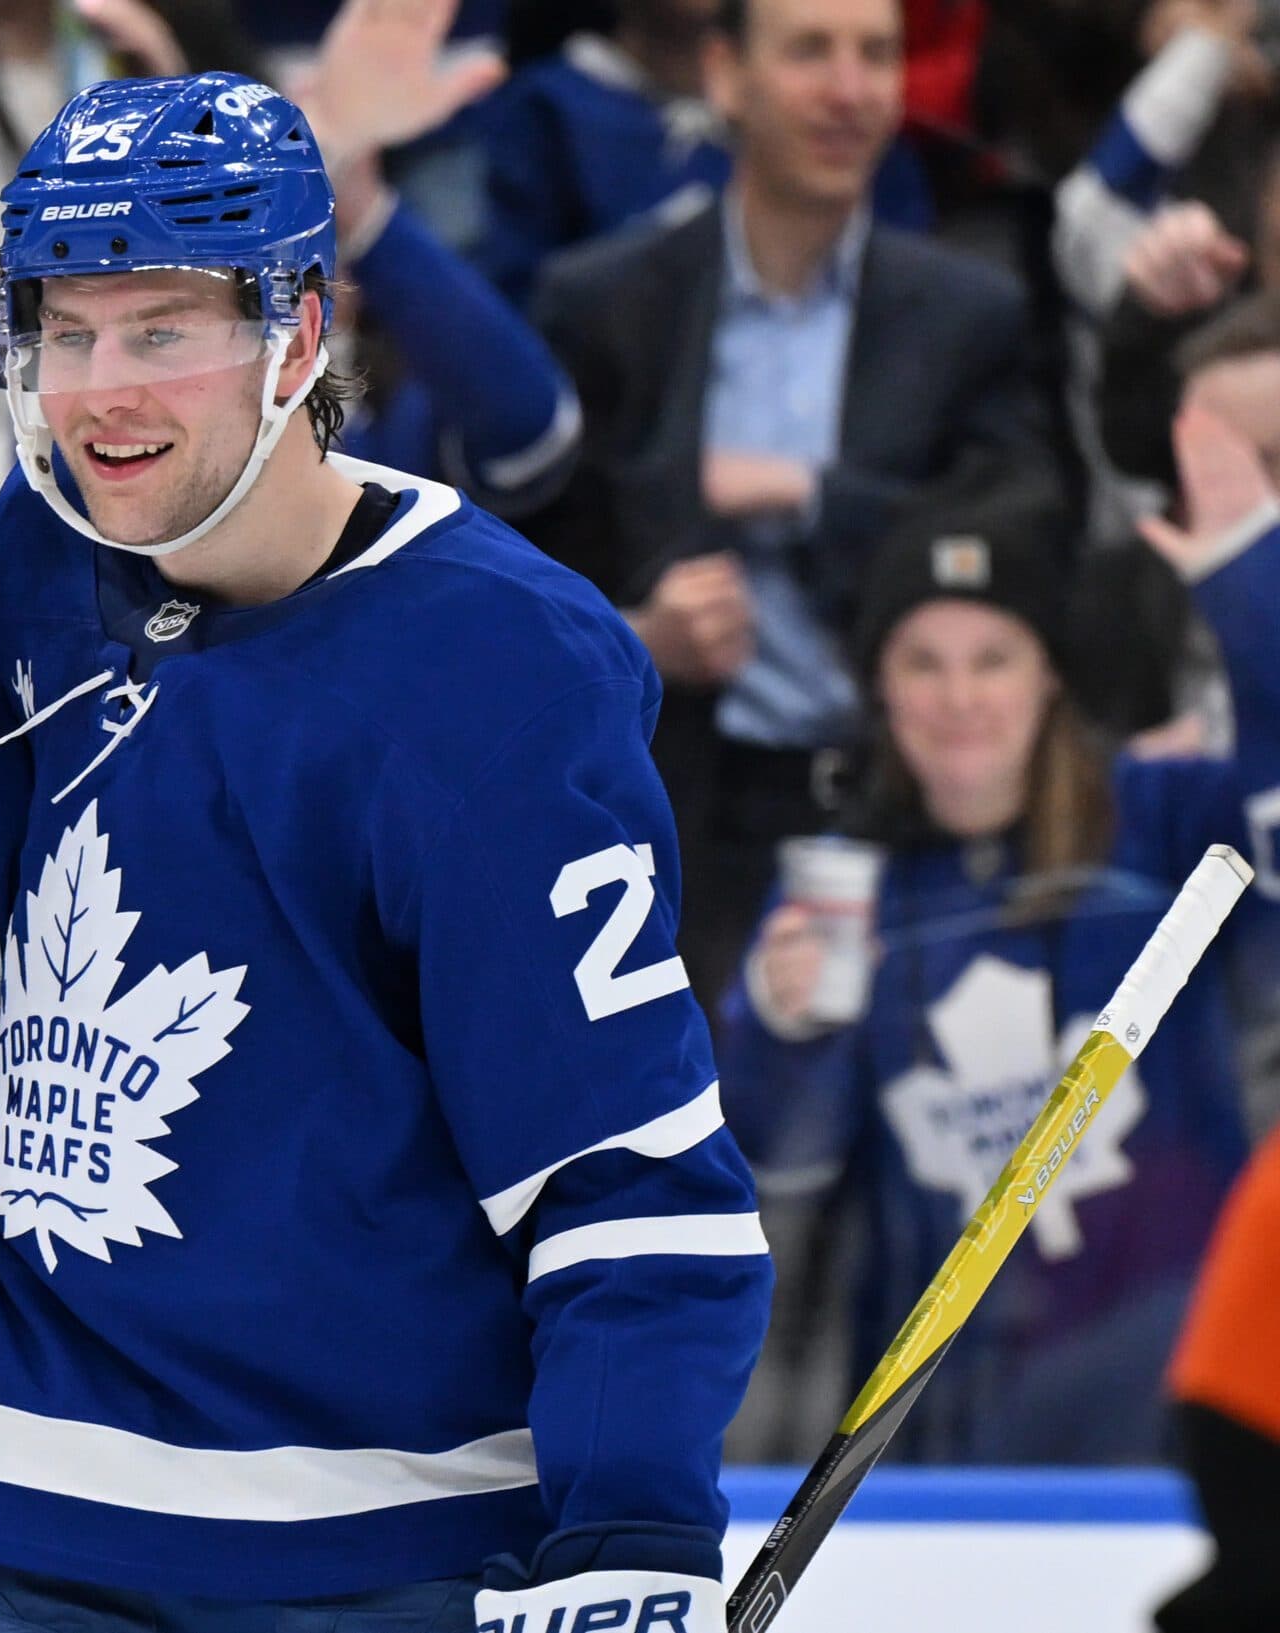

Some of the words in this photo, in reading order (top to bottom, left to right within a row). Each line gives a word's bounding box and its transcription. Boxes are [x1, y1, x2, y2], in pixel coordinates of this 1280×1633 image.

[65, 124, 141, 164] 25
[40, 201, 133, 222] BAUER
[6, 1074, 116, 1134] MAPLE
[2, 1124, 112, 1184] LEAFS
